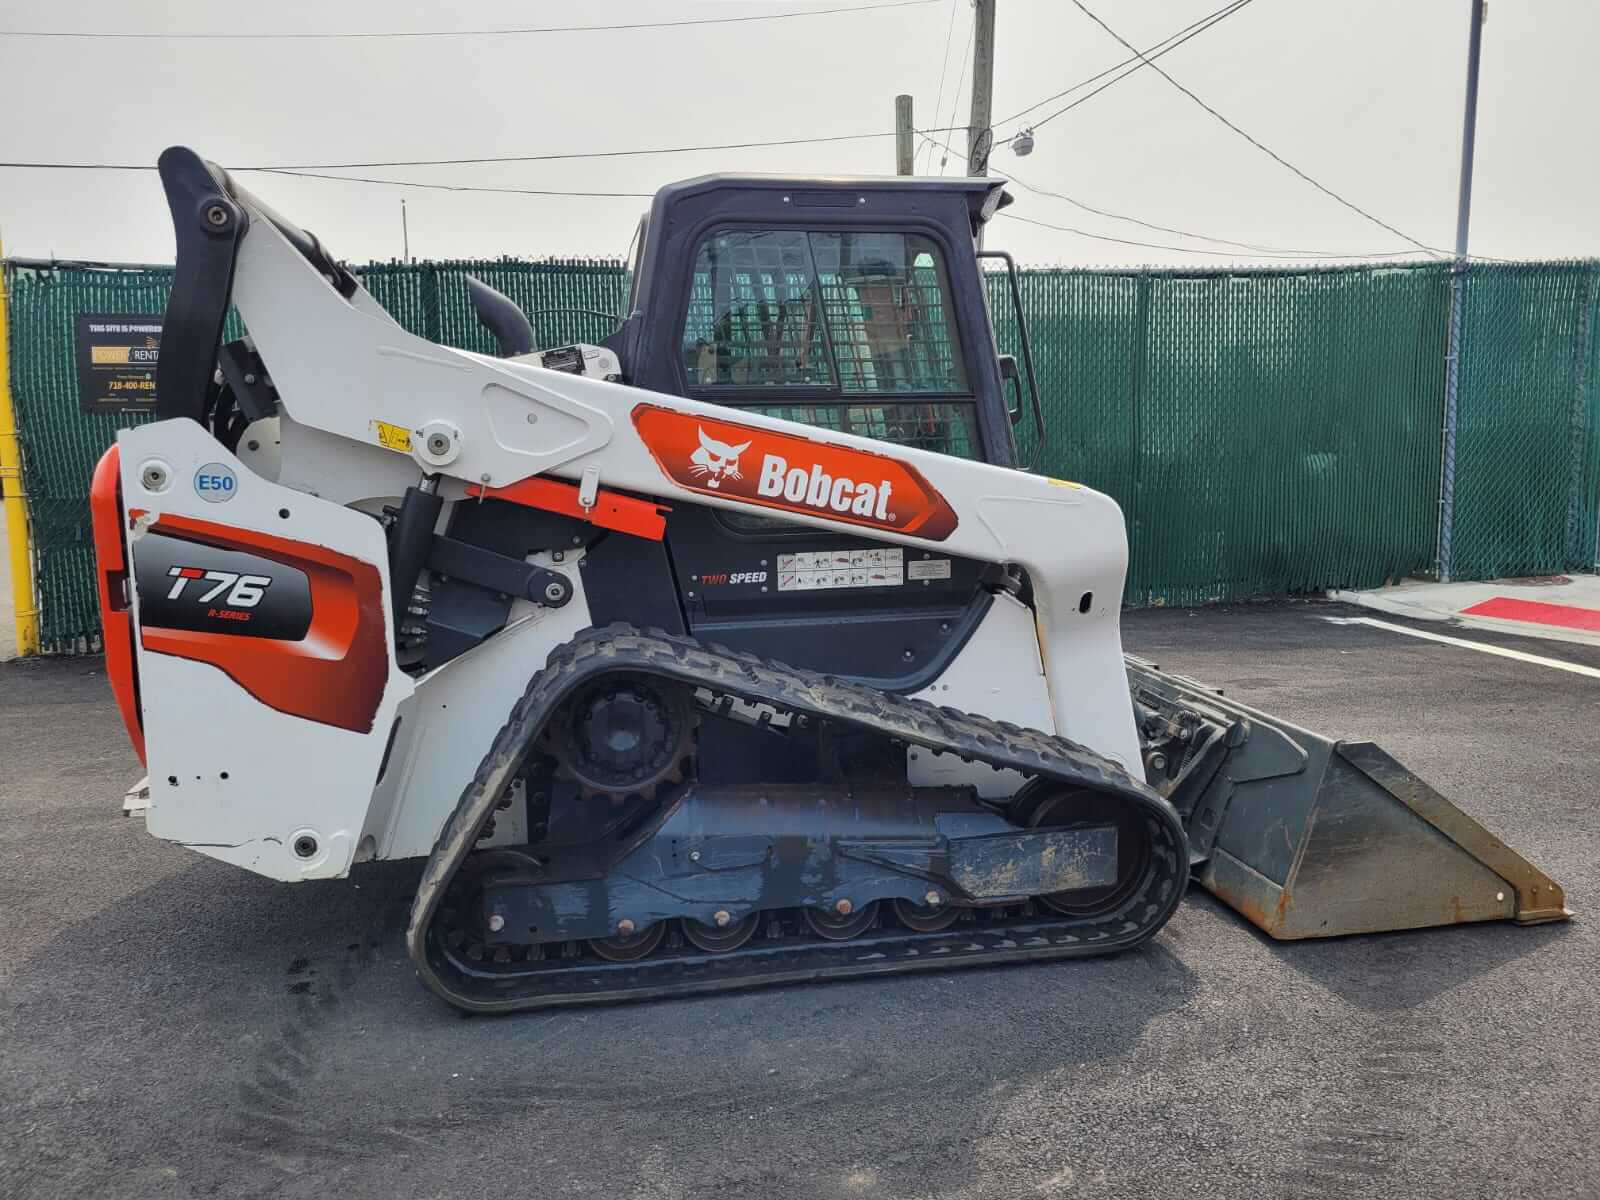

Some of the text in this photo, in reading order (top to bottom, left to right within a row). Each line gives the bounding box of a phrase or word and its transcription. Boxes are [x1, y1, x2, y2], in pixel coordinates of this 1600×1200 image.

[89, 324, 105, 332] THIS
[105, 324, 120, 332] SITE
[121, 324, 128, 332] IS
[108, 381, 156, 389] 718-400-REN
[198, 475, 233, 490] E50
[757, 453, 893, 520] Bobcat
[700, 571, 767, 585] TWO SPEED
[166, 566, 273, 608] T76
[207, 608, 252, 621] R-SERIES
